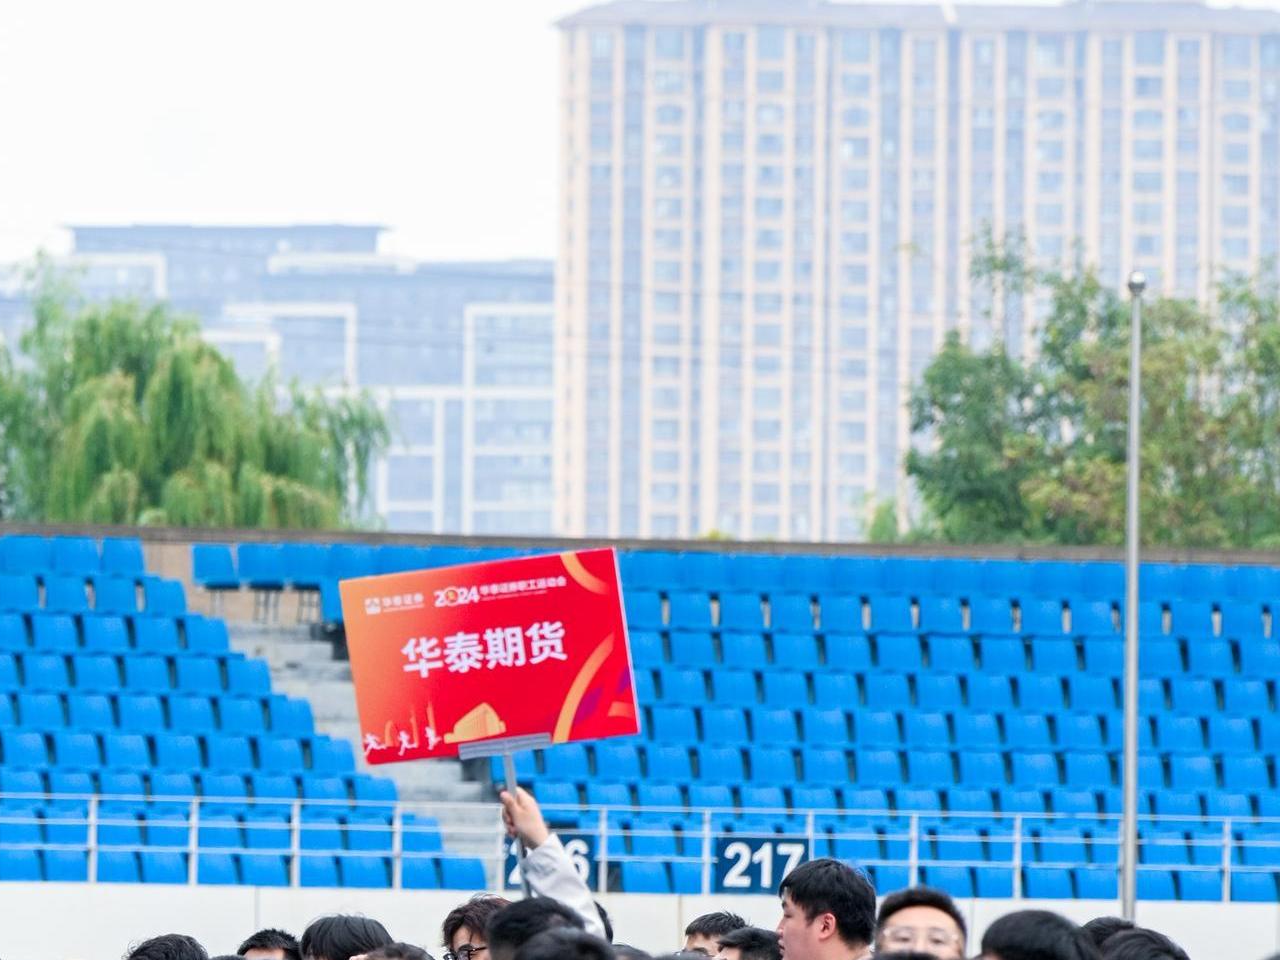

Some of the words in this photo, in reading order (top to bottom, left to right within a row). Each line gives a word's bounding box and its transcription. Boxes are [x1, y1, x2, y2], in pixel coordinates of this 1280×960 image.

[433, 586, 480, 608] 2024
[400, 620, 568, 679] 华泰期货
[722, 841, 805, 888] 217
